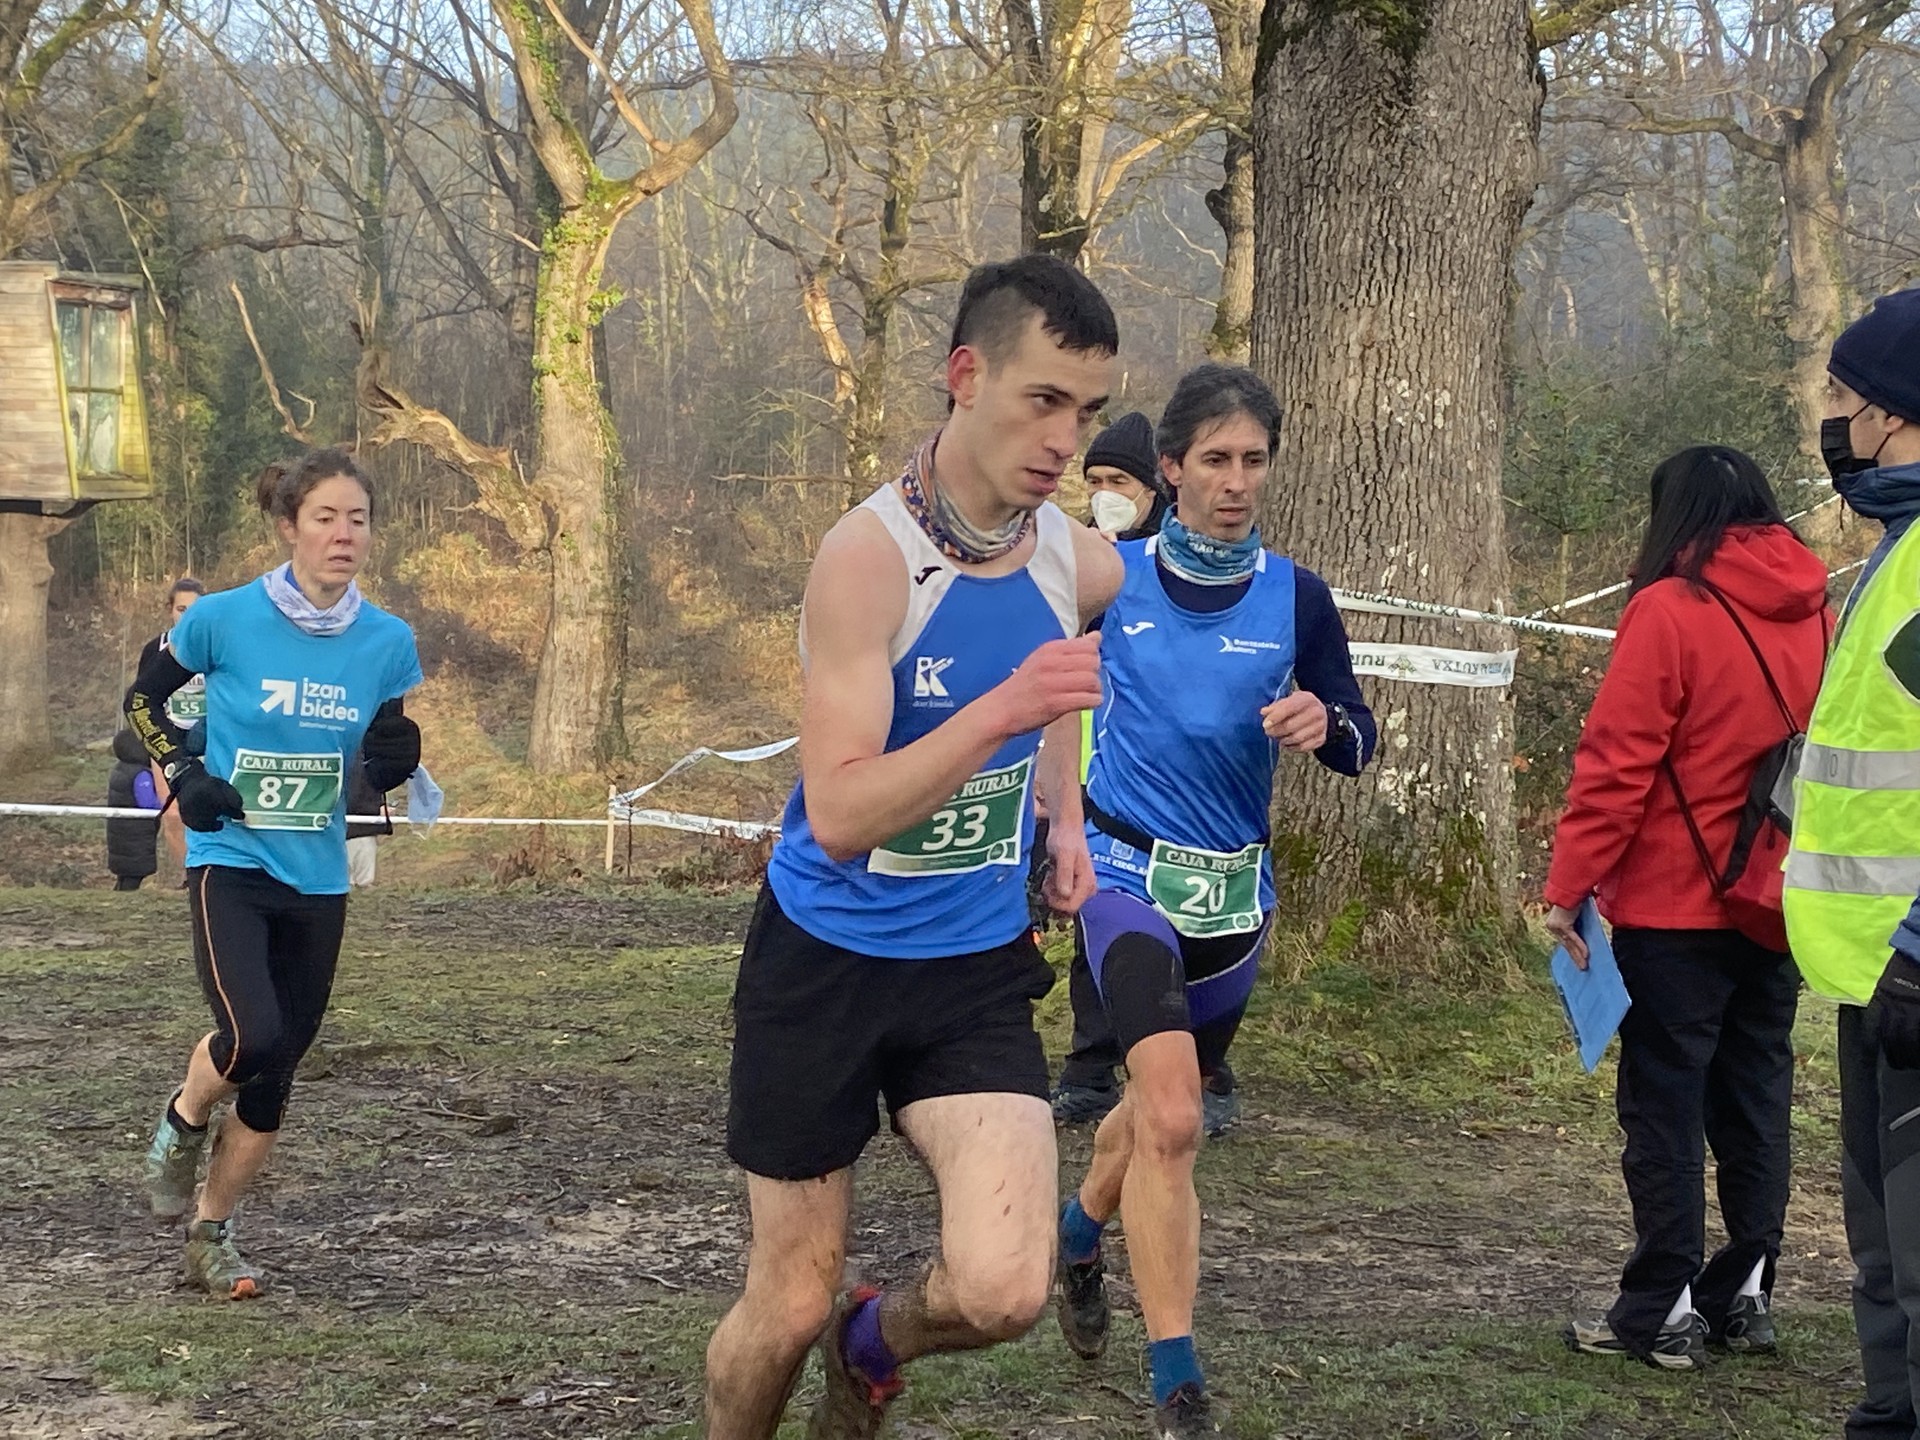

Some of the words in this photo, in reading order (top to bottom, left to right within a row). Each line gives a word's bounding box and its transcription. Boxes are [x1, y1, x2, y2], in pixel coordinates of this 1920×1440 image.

[302, 677, 347, 701] izan
[180, 702, 200, 714] 55
[300, 698, 359, 722] bidea
[242, 756, 277, 770] CAJA
[281, 759, 332, 771] RURAL
[257, 776, 309, 809] 87
[960, 771, 1020, 798] RURAL
[921, 804, 990, 851] 33
[1166, 850, 1206, 869] CAJA
[1179, 876, 1227, 914] 20
